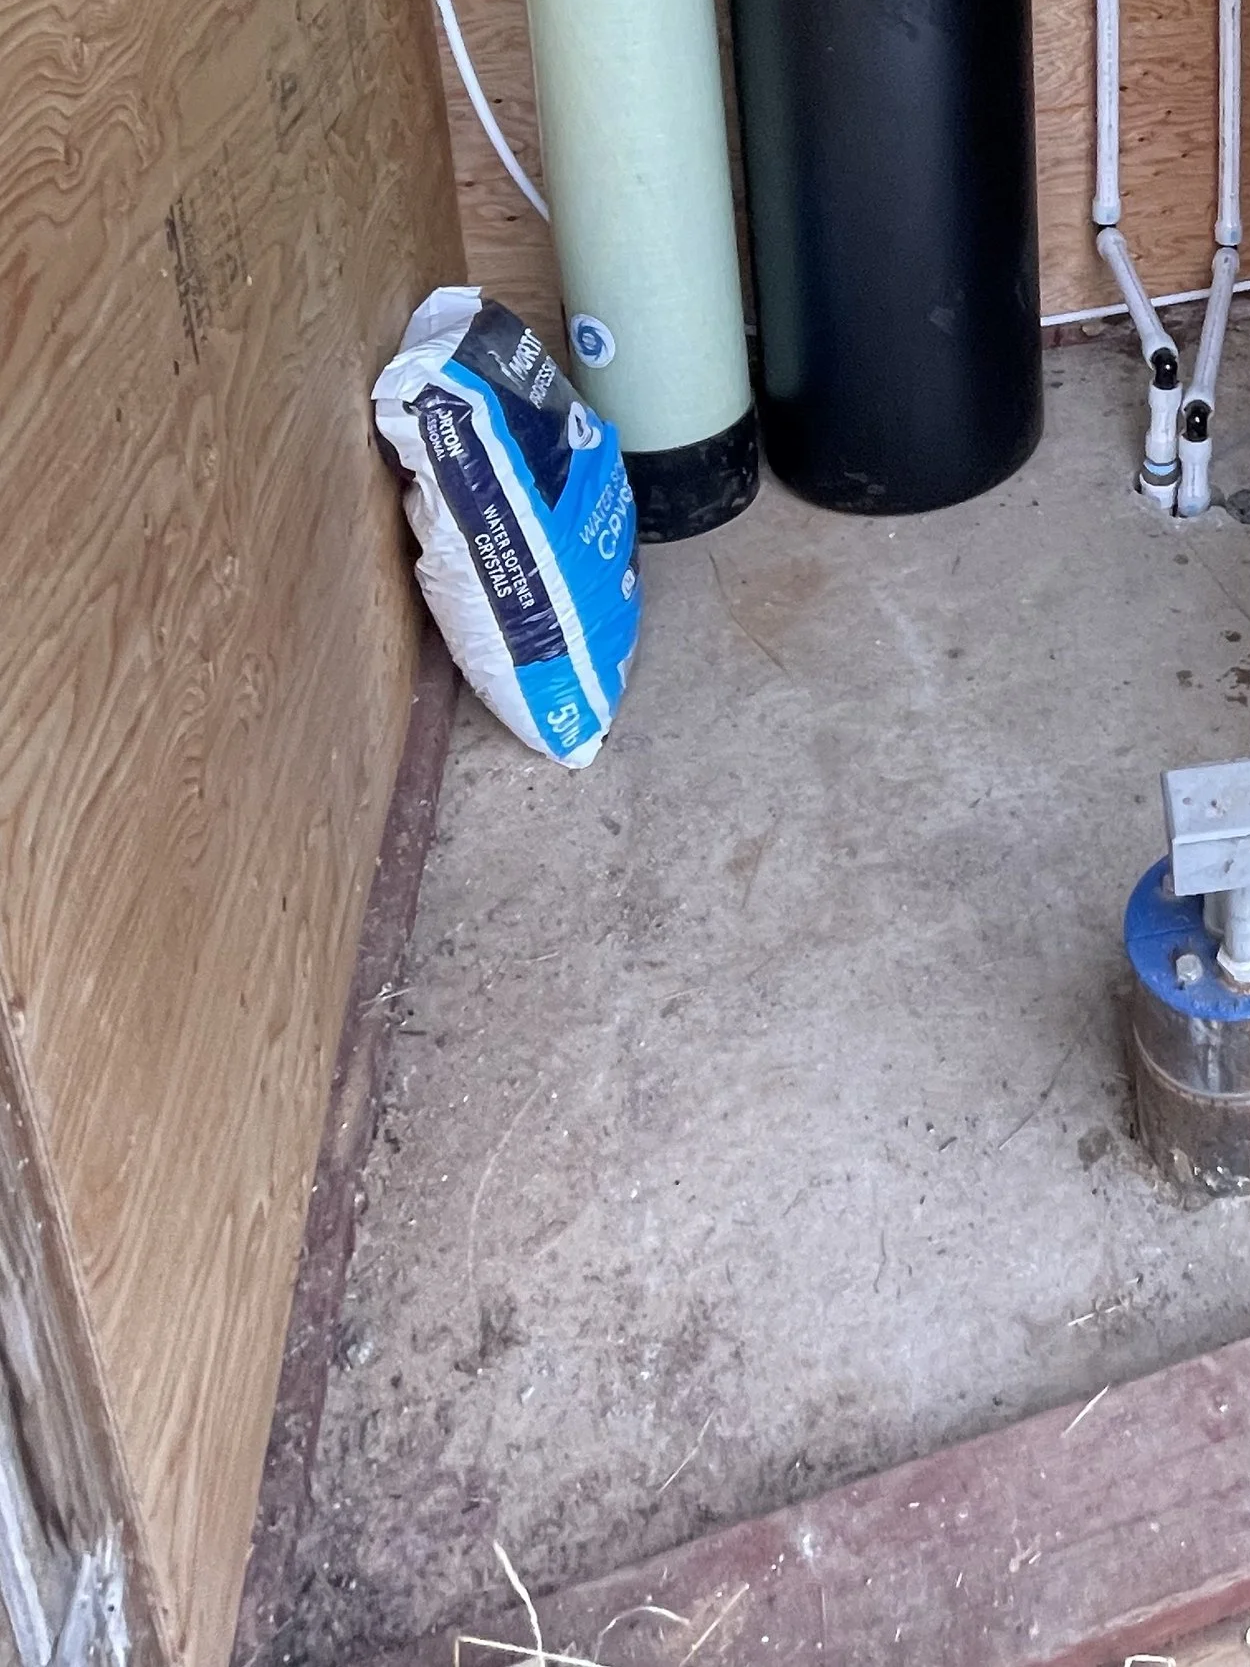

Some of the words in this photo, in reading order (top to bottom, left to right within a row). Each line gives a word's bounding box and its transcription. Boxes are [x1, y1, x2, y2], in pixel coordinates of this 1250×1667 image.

[509, 327, 542, 382] MORT
[435, 406, 464, 458] ORTON
[474, 532, 513, 599] CRYSTALS
[483, 503, 510, 550] WATER
[501, 549, 536, 610] SOFTENER
